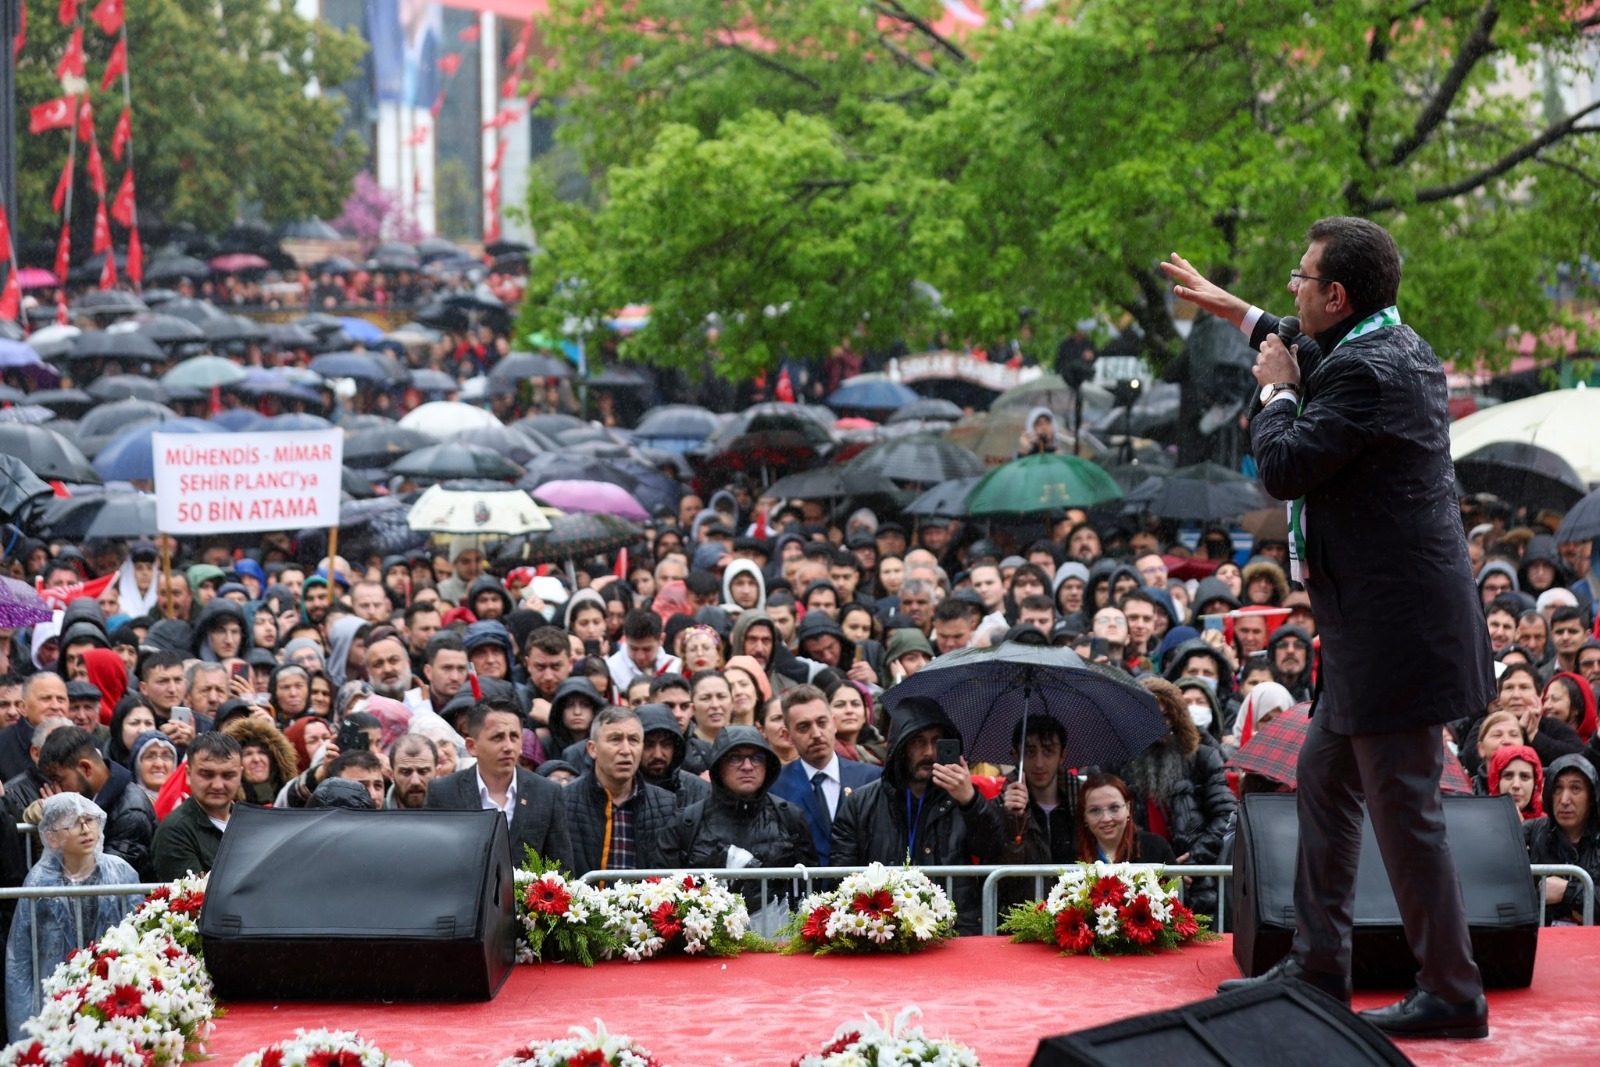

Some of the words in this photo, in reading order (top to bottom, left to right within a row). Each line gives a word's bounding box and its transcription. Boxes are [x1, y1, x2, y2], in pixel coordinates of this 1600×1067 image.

[165, 445, 260, 466] MÜHENDİS
[274, 441, 333, 463] MİMAR
[180, 471, 230, 494] ŞEHİR
[178, 502, 202, 523] 50
[208, 497, 243, 522] BİN
[248, 497, 318, 519] ATAMA
